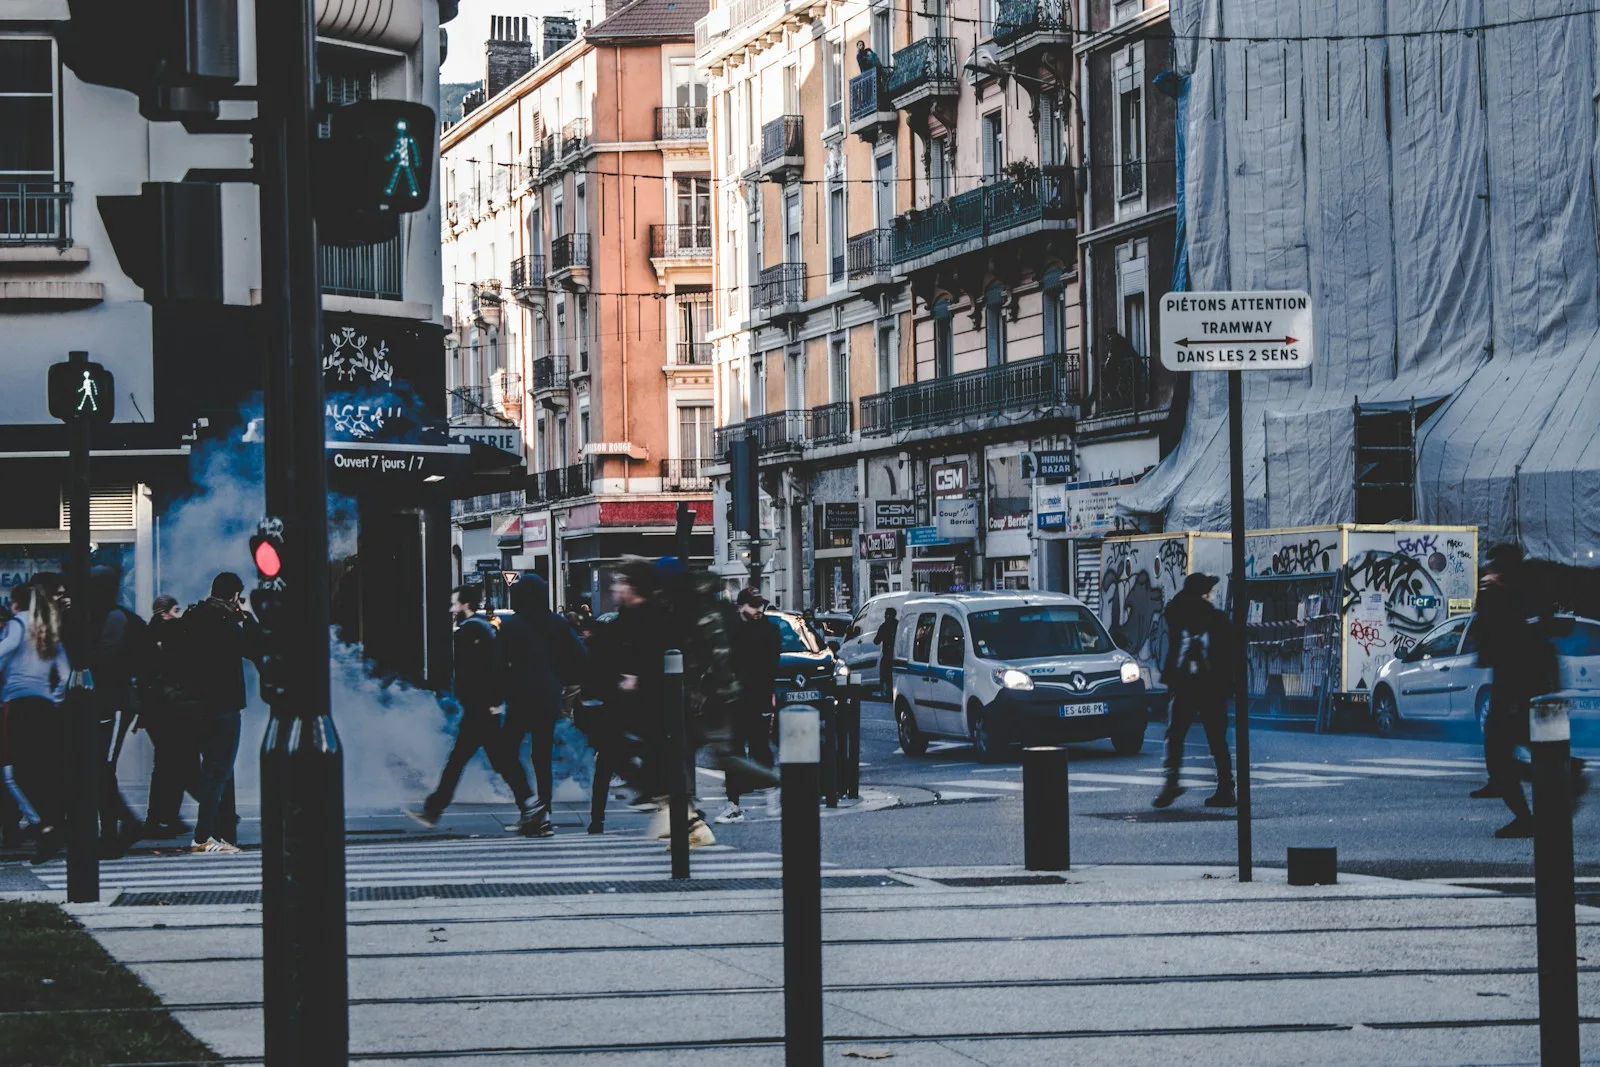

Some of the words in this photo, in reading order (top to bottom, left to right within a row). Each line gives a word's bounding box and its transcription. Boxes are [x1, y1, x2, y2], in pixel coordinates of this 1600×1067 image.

[1166, 297, 1227, 312] PIÉTONS
[1231, 297, 1306, 311] ATTENTION
[1202, 321, 1273, 334] TRAMWAY
[1177, 351, 1215, 363] DANS
[1219, 350, 1244, 362] LES
[1249, 349, 1257, 361] 2
[1261, 349, 1299, 361] SENS
[334, 453, 370, 468] Ouvert
[371, 455, 379, 469] 7
[381, 455, 406, 473] jours
[416, 456, 425, 470] 7
[1041, 455, 1070, 464] INDIAN
[1041, 464, 1071, 474] BAZAR
[935, 467, 963, 491] GSM
[877, 504, 915, 515] GSM
[877, 516, 915, 526] PHONE
[868, 534, 880, 551] Chez
